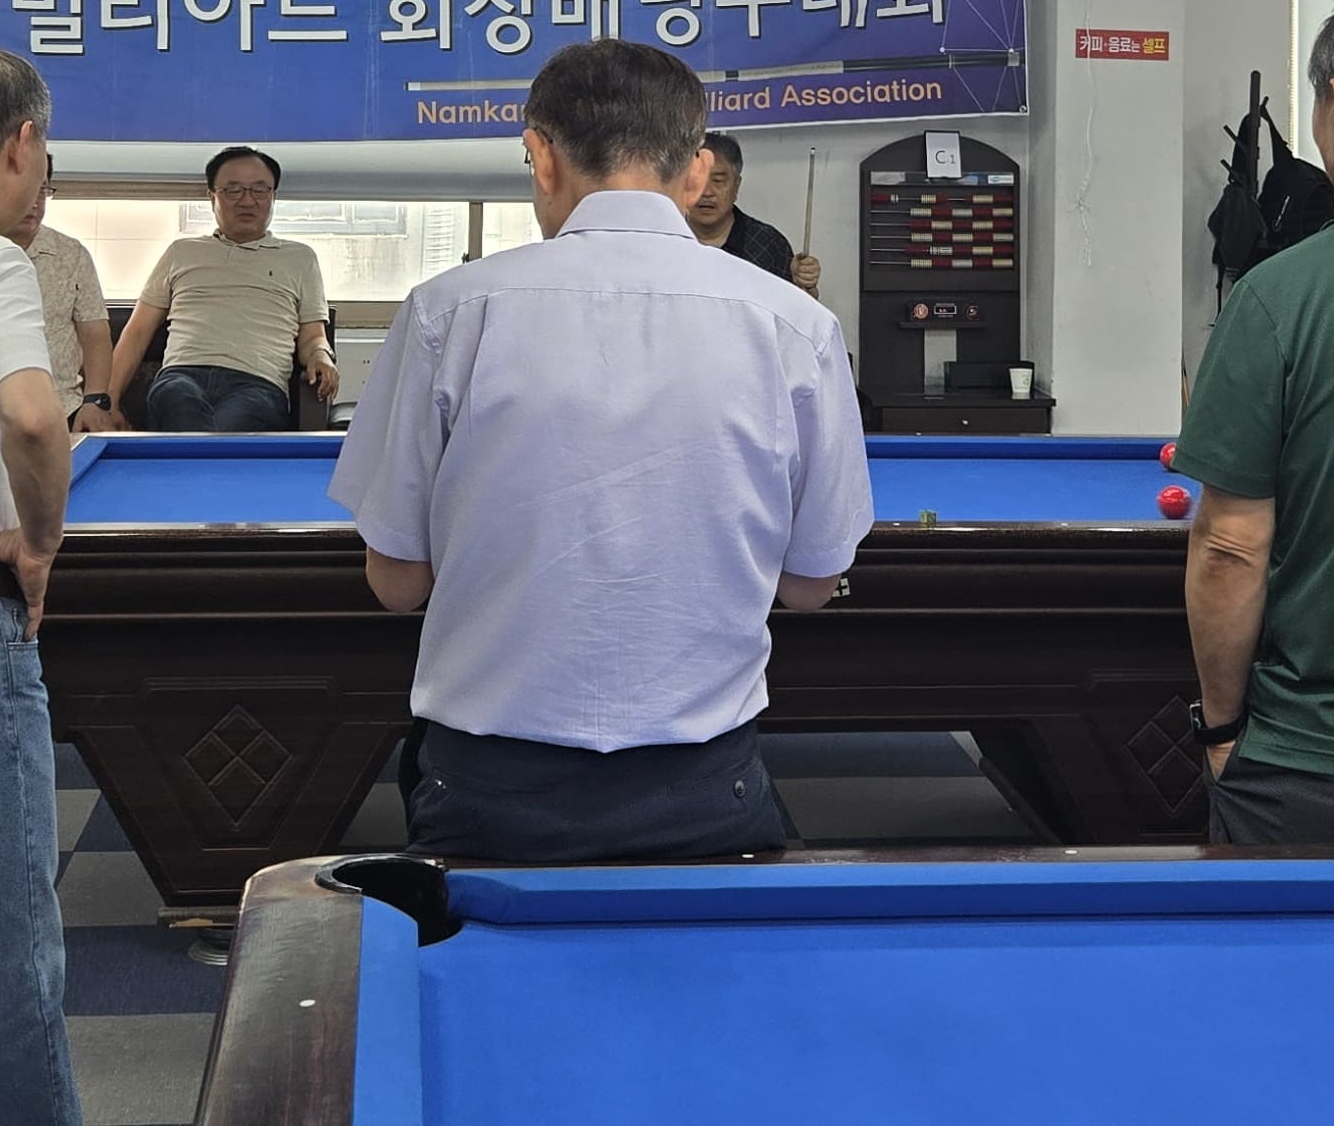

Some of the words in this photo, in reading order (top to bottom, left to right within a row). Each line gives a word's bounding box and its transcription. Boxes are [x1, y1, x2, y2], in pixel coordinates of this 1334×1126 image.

[1142, 37, 1166, 54] 셀프
[417, 100, 526, 124] Namka
[780, 79, 943, 108] Association
